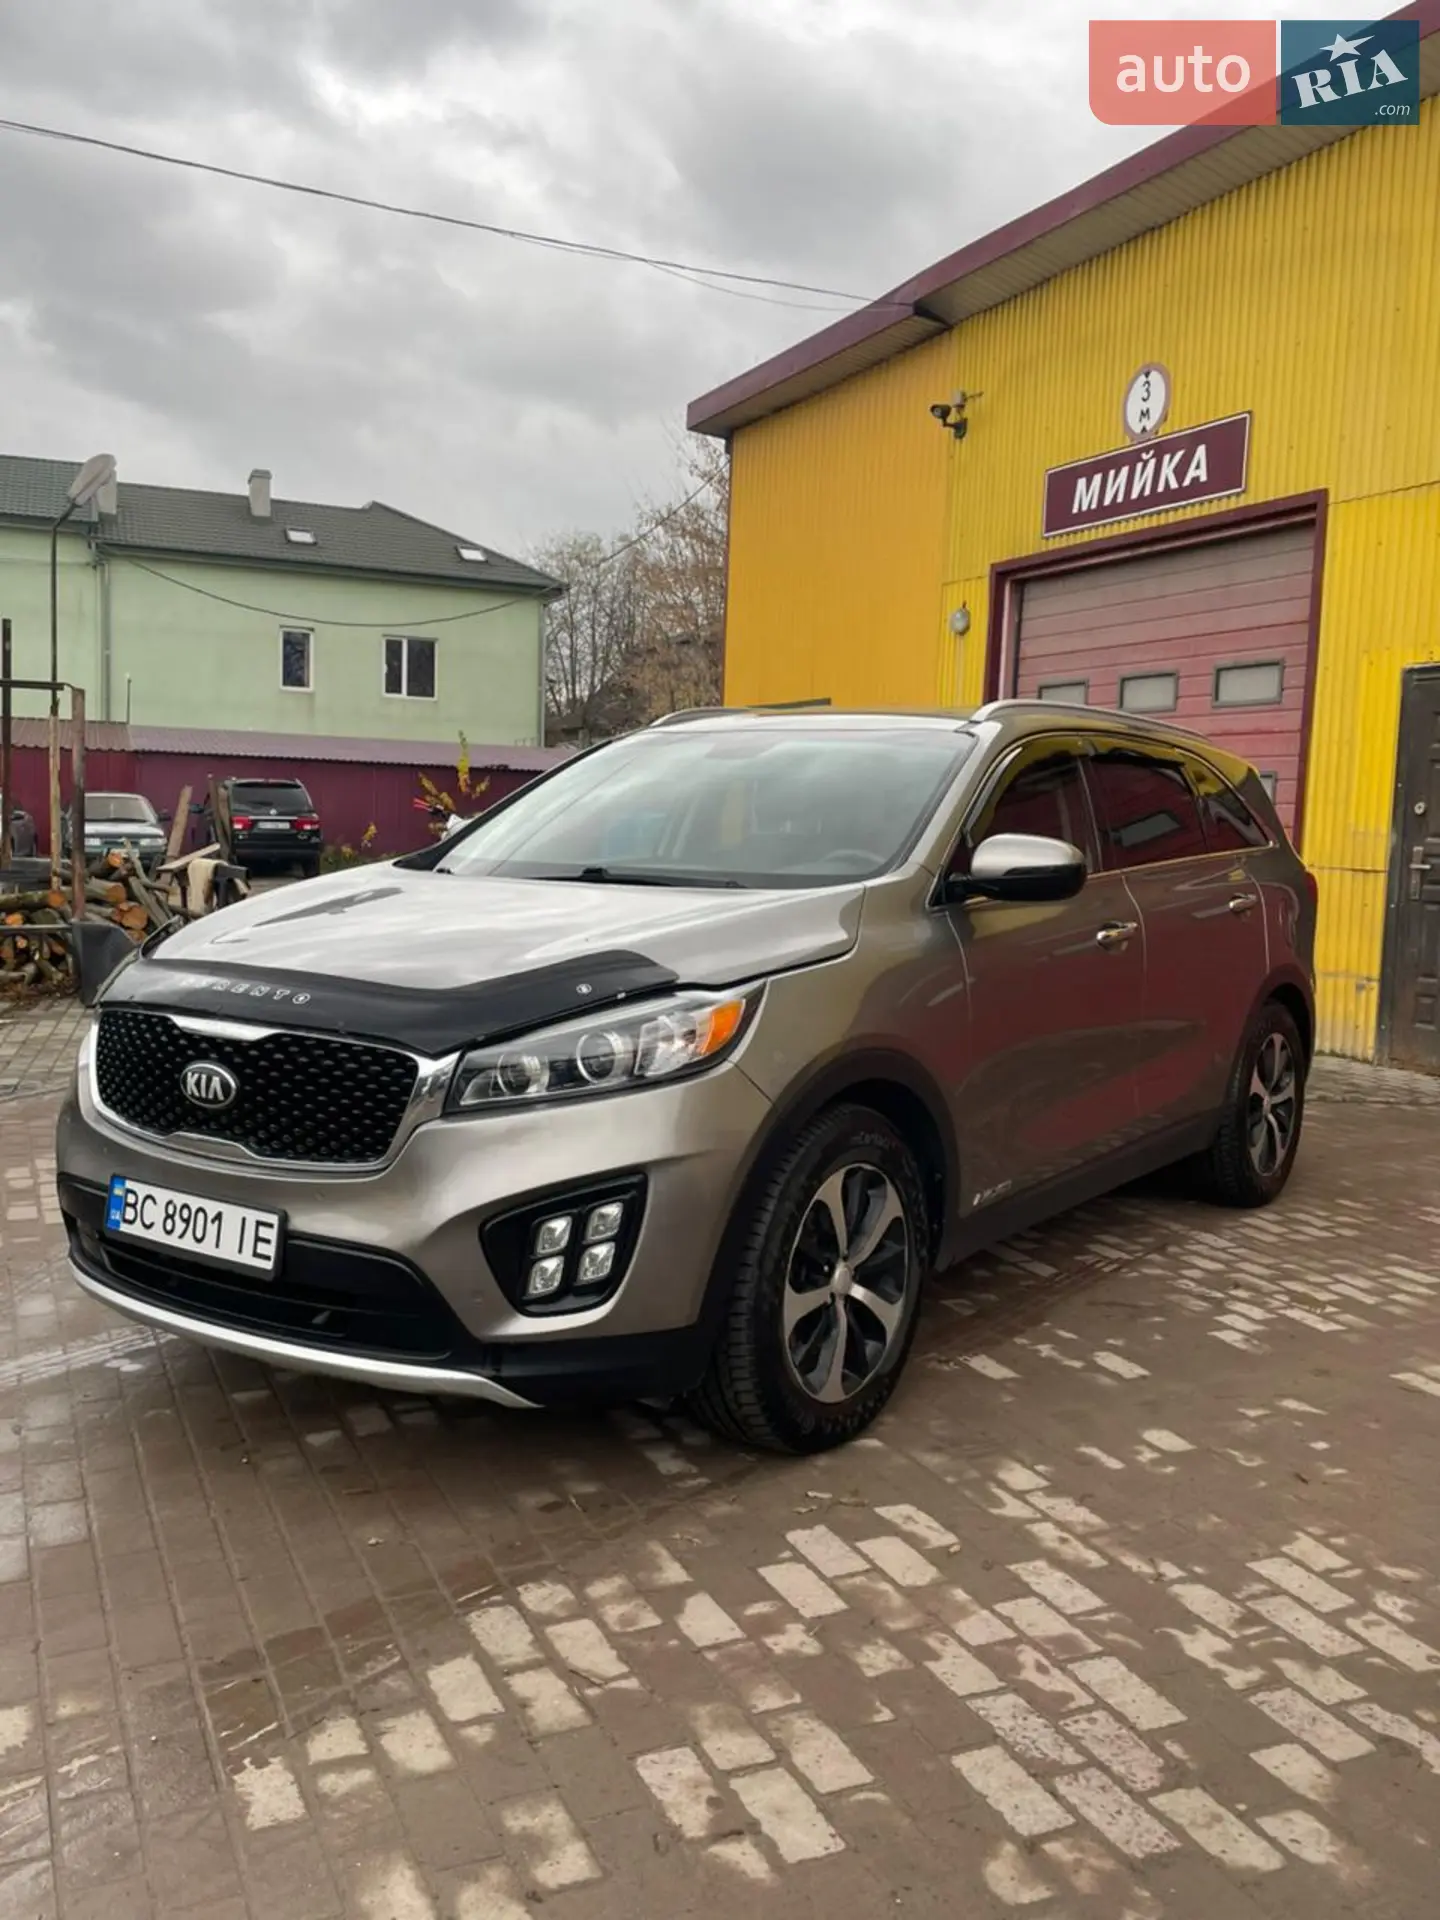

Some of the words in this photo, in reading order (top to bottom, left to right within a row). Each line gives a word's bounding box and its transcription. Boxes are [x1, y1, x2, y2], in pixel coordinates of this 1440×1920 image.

[1141, 380, 1151, 402] 3
[1071, 443, 1208, 514] МИЙКА
[186, 1072, 224, 1101] KIA
[121, 1188, 157, 1230] BC
[162, 1200, 224, 1249] 8901
[238, 1216, 275, 1262] IE
